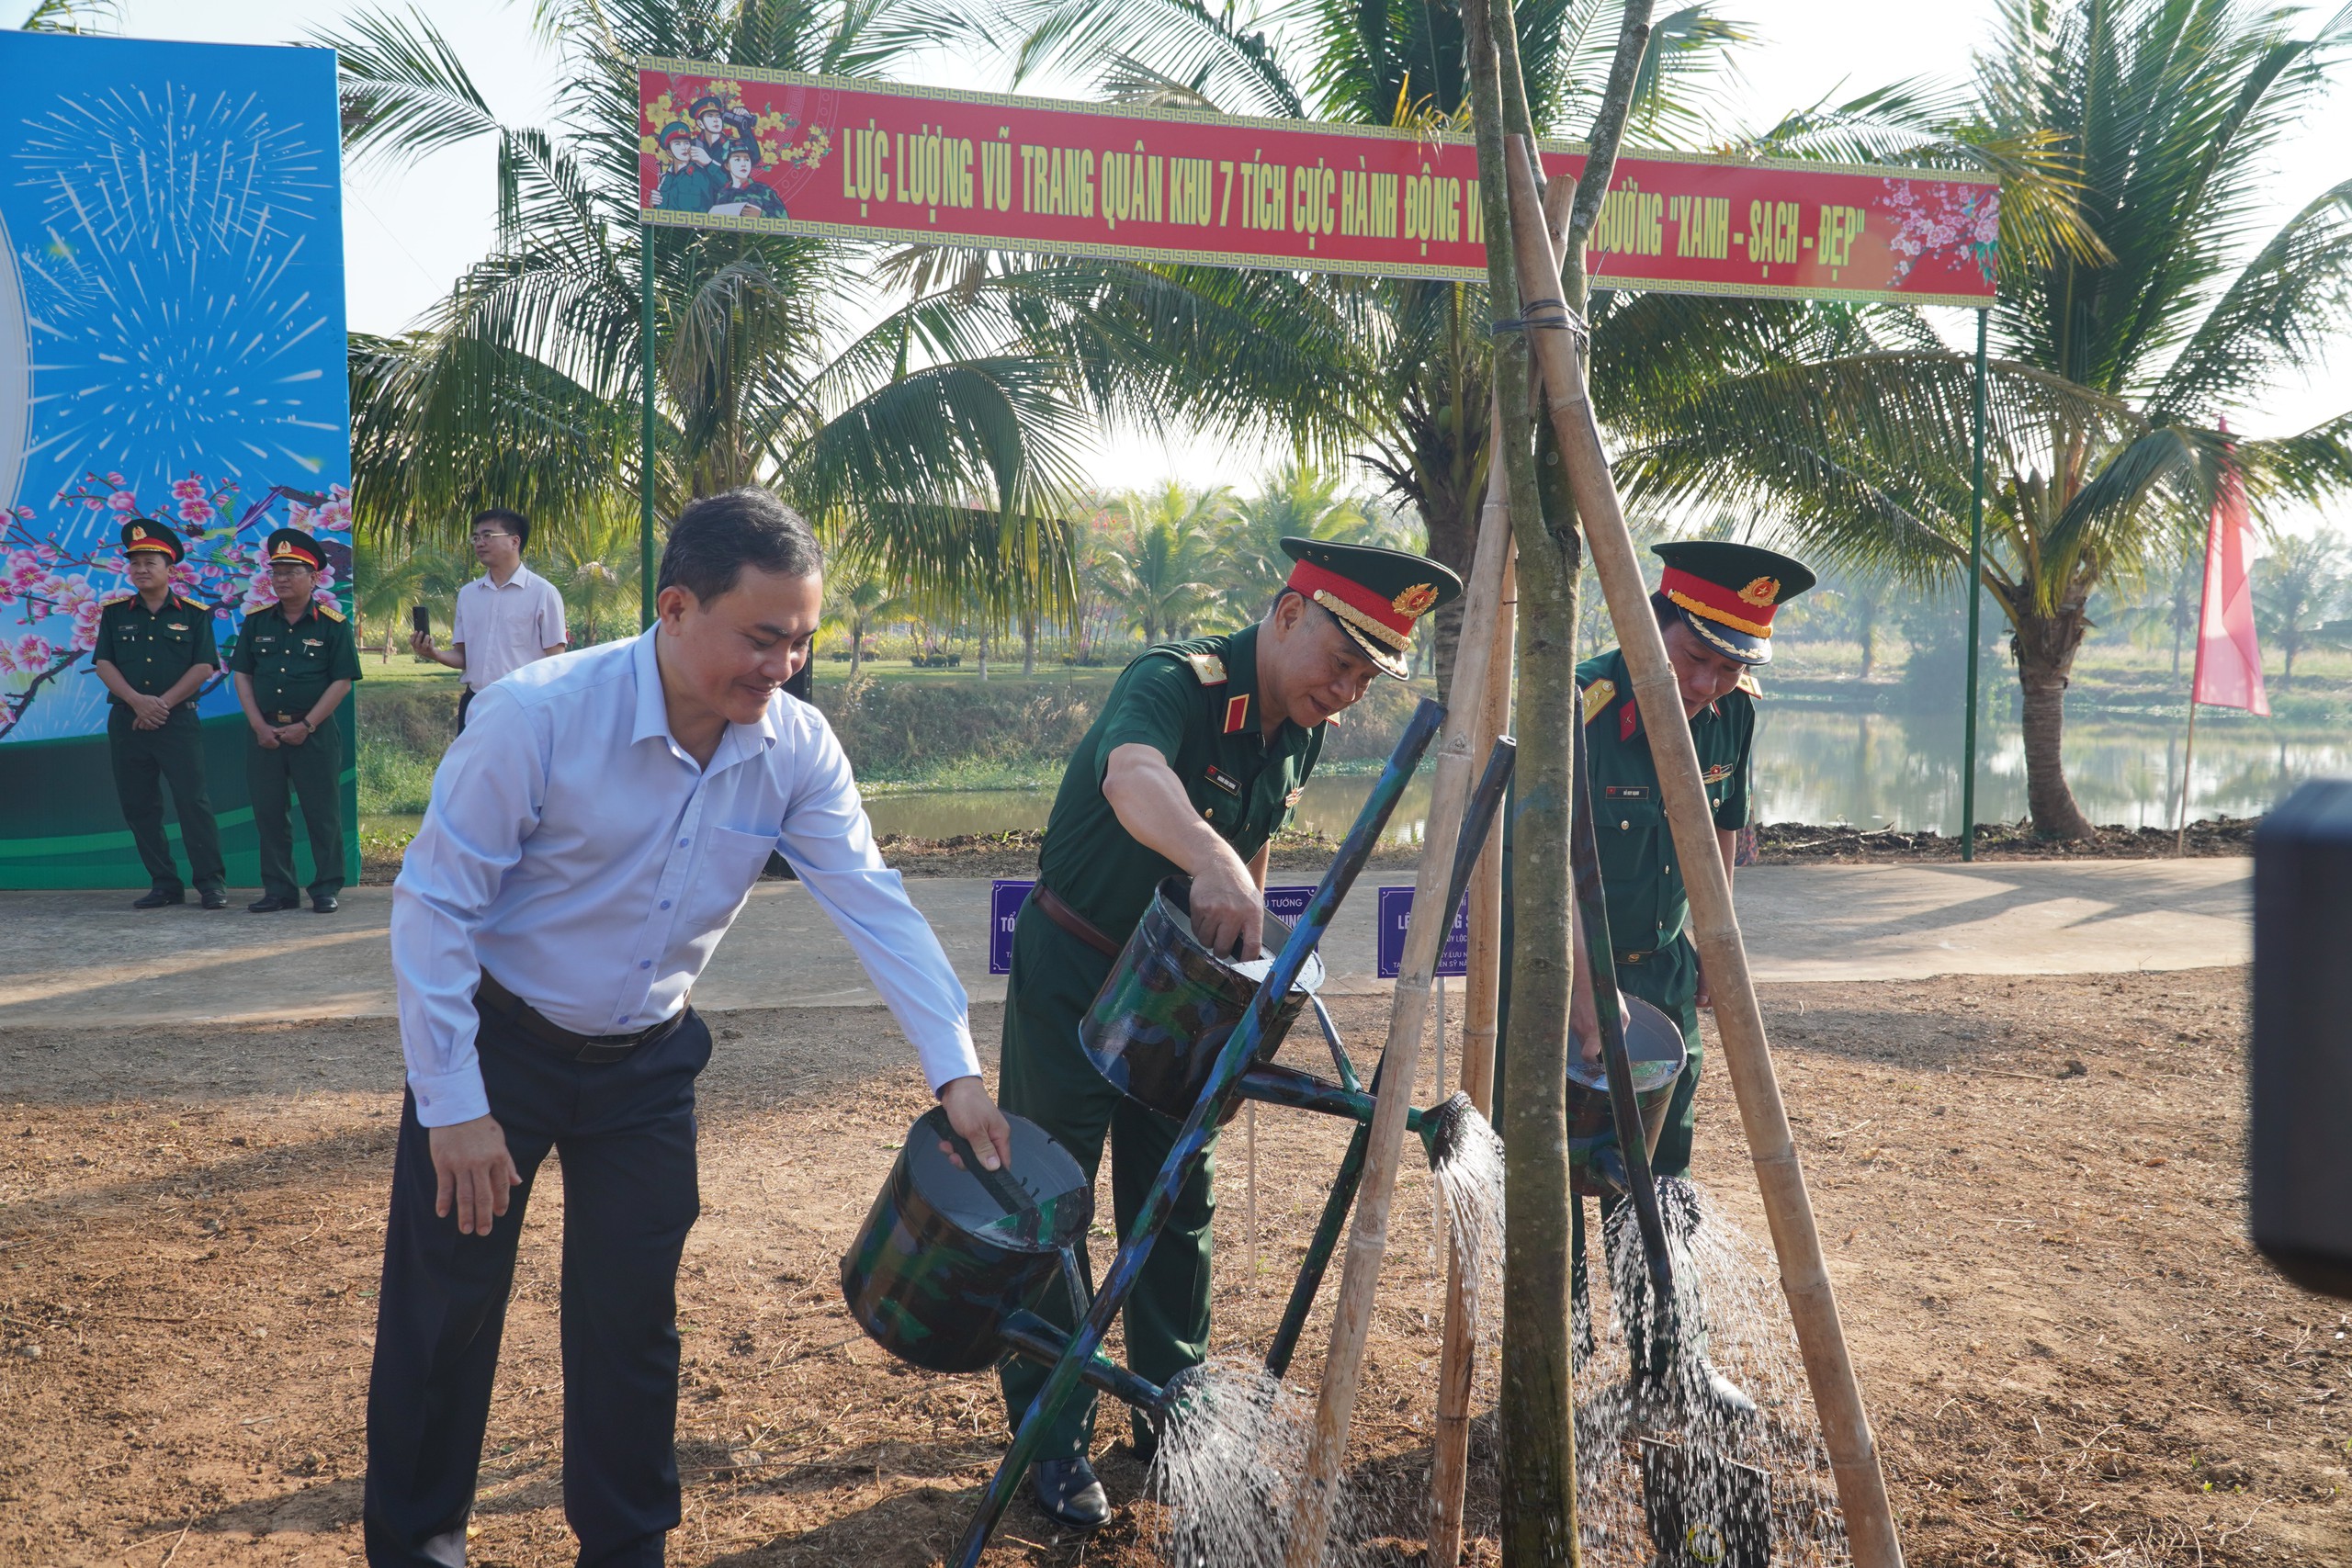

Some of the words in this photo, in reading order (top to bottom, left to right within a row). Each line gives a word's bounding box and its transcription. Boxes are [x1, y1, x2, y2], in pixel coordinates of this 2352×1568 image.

[842, 118, 889, 219] LỰC
[897, 124, 973, 223] LƯỢNG
[981, 126, 1012, 212] VŨ
[1021, 144, 1095, 218] TRANG
[1102, 141, 1162, 230] QUÂN
[1170, 156, 1213, 228] KHU
[1219, 161, 1234, 228] 7
[1240, 149, 1286, 231] TÍCH
[1292, 157, 1336, 251] CỰC
[1340, 155, 1398, 239] HÀNH
[1404, 163, 1461, 256] ĐỘNG
[1588, 175, 1664, 256] RƯỜNG
[1748, 200, 1799, 277] SẠCH
[1272, 897, 1303, 908] TƯỚNG
